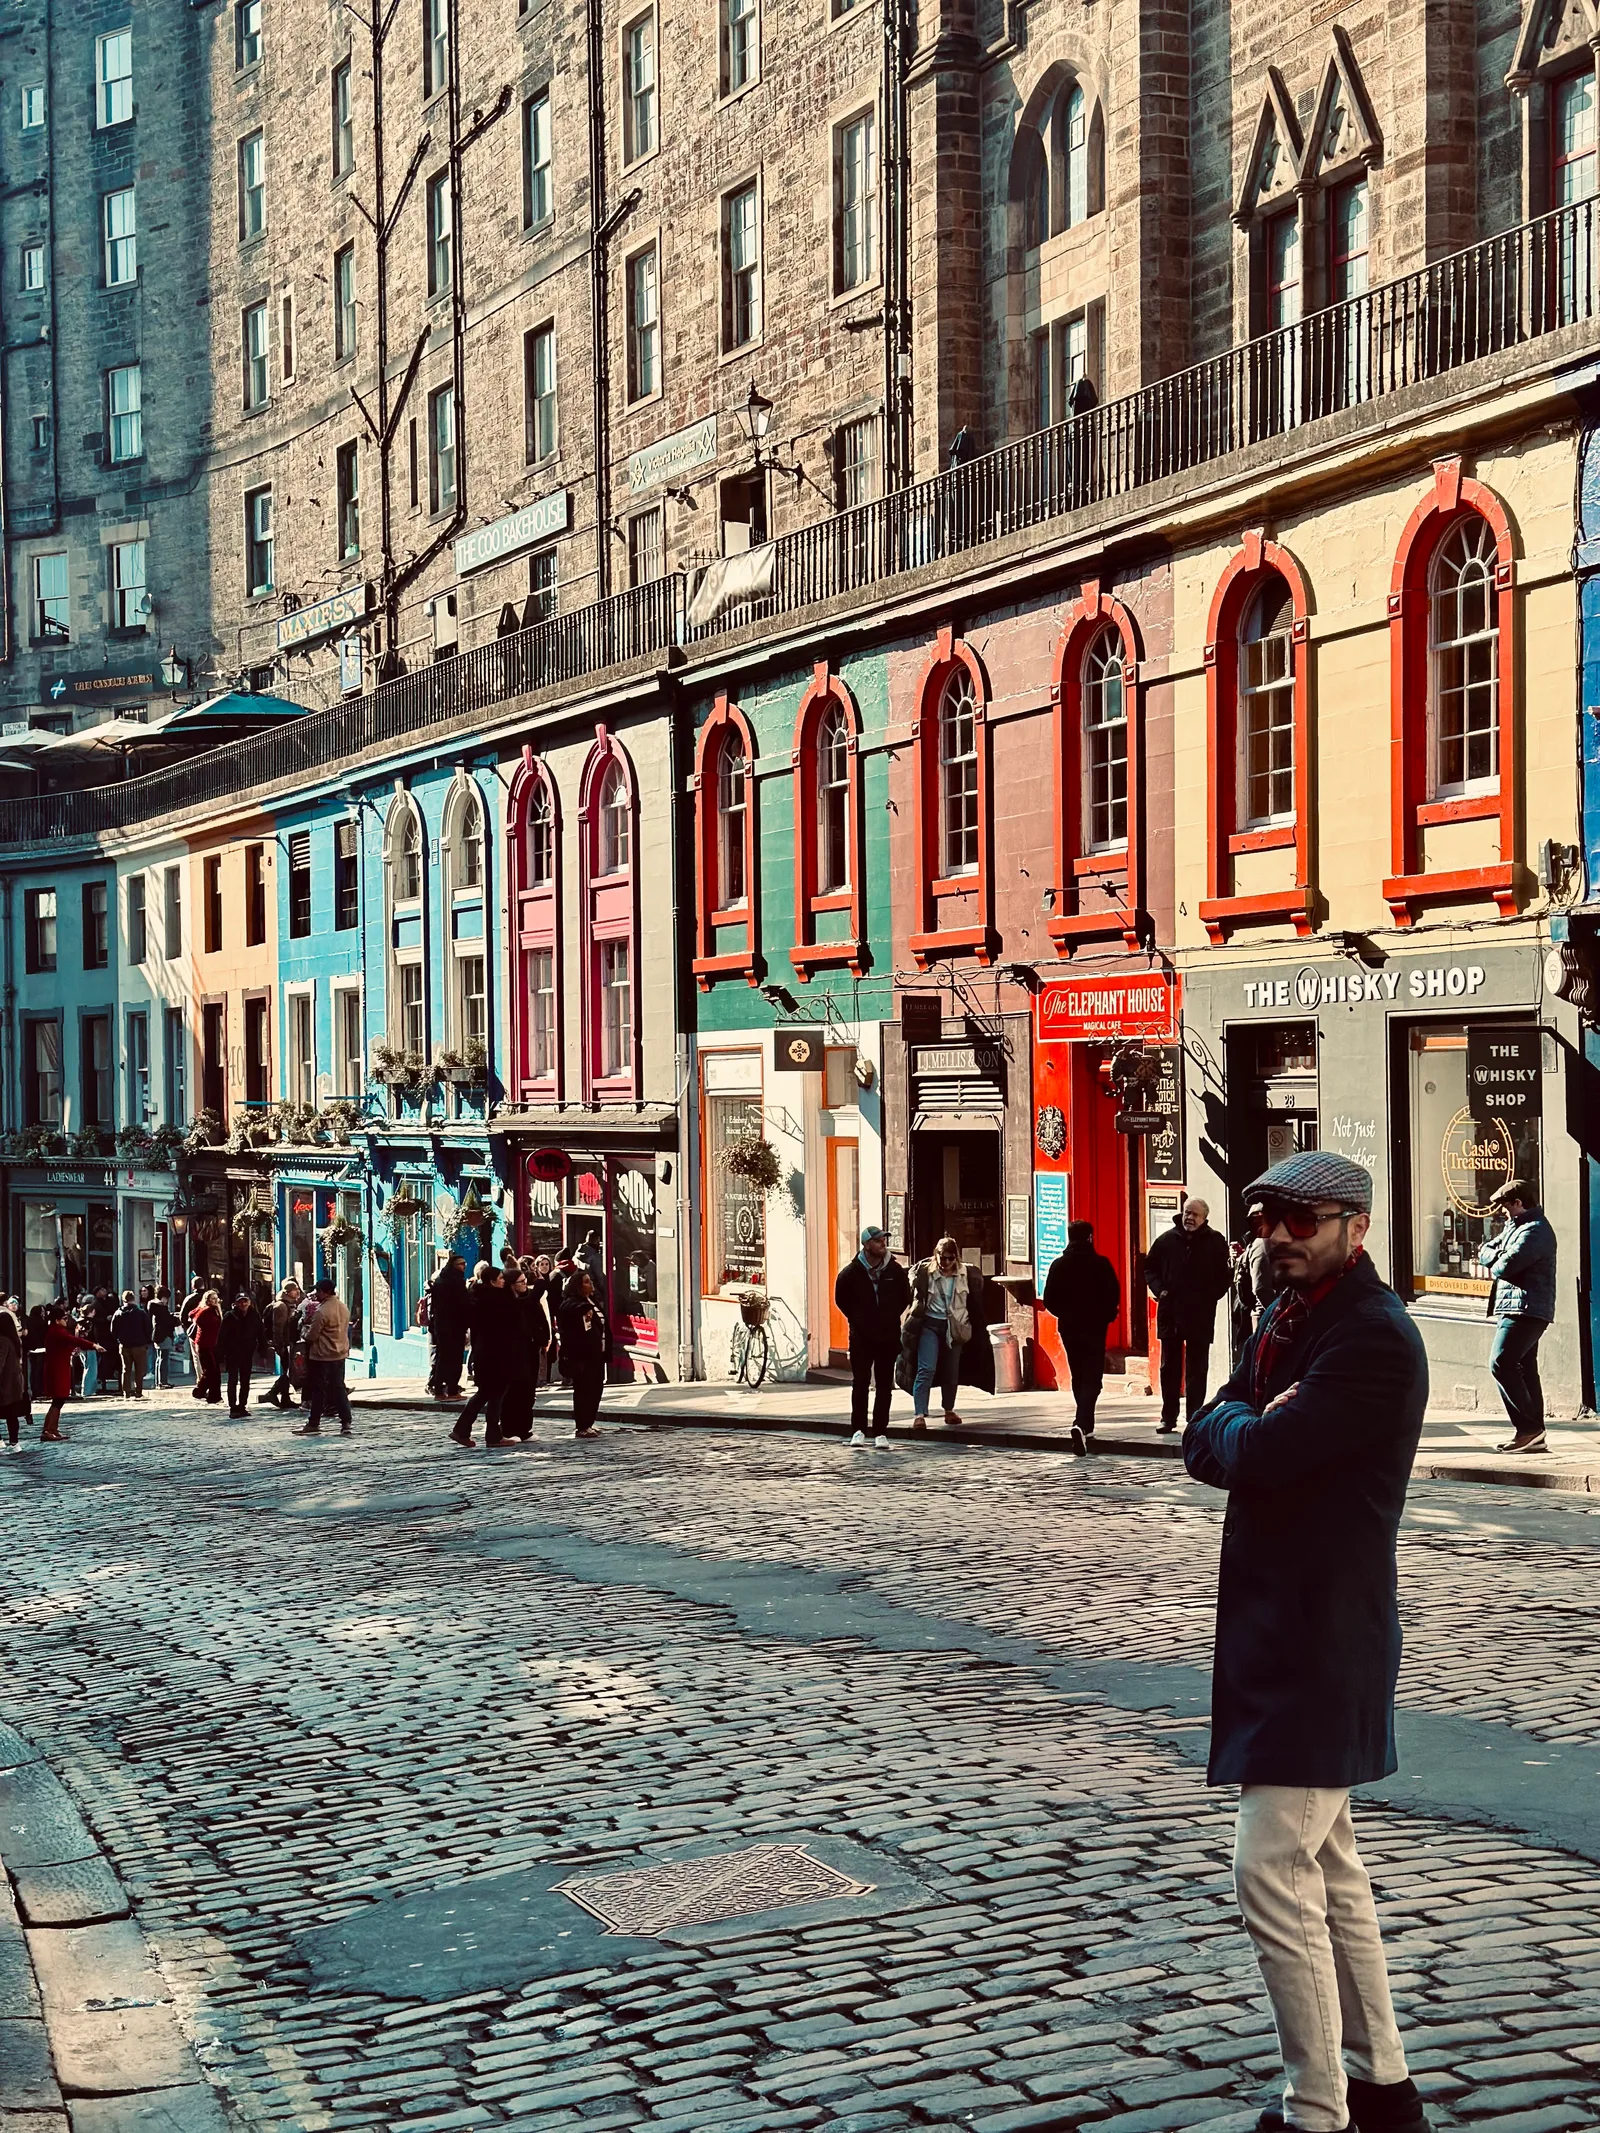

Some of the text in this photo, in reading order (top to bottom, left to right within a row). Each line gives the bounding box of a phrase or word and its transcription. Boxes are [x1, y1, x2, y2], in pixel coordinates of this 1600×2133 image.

[457, 499, 565, 567] THE COO BAKEHOUSE
[74, 673, 153, 692] THE CASTLE ARMS
[1244, 966, 1485, 1007] THE WHISKY SHOP
[1043, 986, 1165, 1021] The ELEPHANT HOUSE
[1083, 1020, 1122, 1031] MAGICAL CAFE
[976, 1050, 999, 1068] SON
[1490, 1045, 1519, 1057] THE
[1475, 1068, 1537, 1082] WHISKY
[1284, 1094, 1295, 1108] 28
[1485, 1094, 1526, 1106] SHOP
[1332, 1115, 1376, 1147] Not Just
[1462, 1138, 1493, 1158] Cask
[1448, 1153, 1508, 1171] Treasures
[47, 1172, 85, 1184] LADIESWEAR
[1430, 1280, 1468, 1290] DISCOVERED
